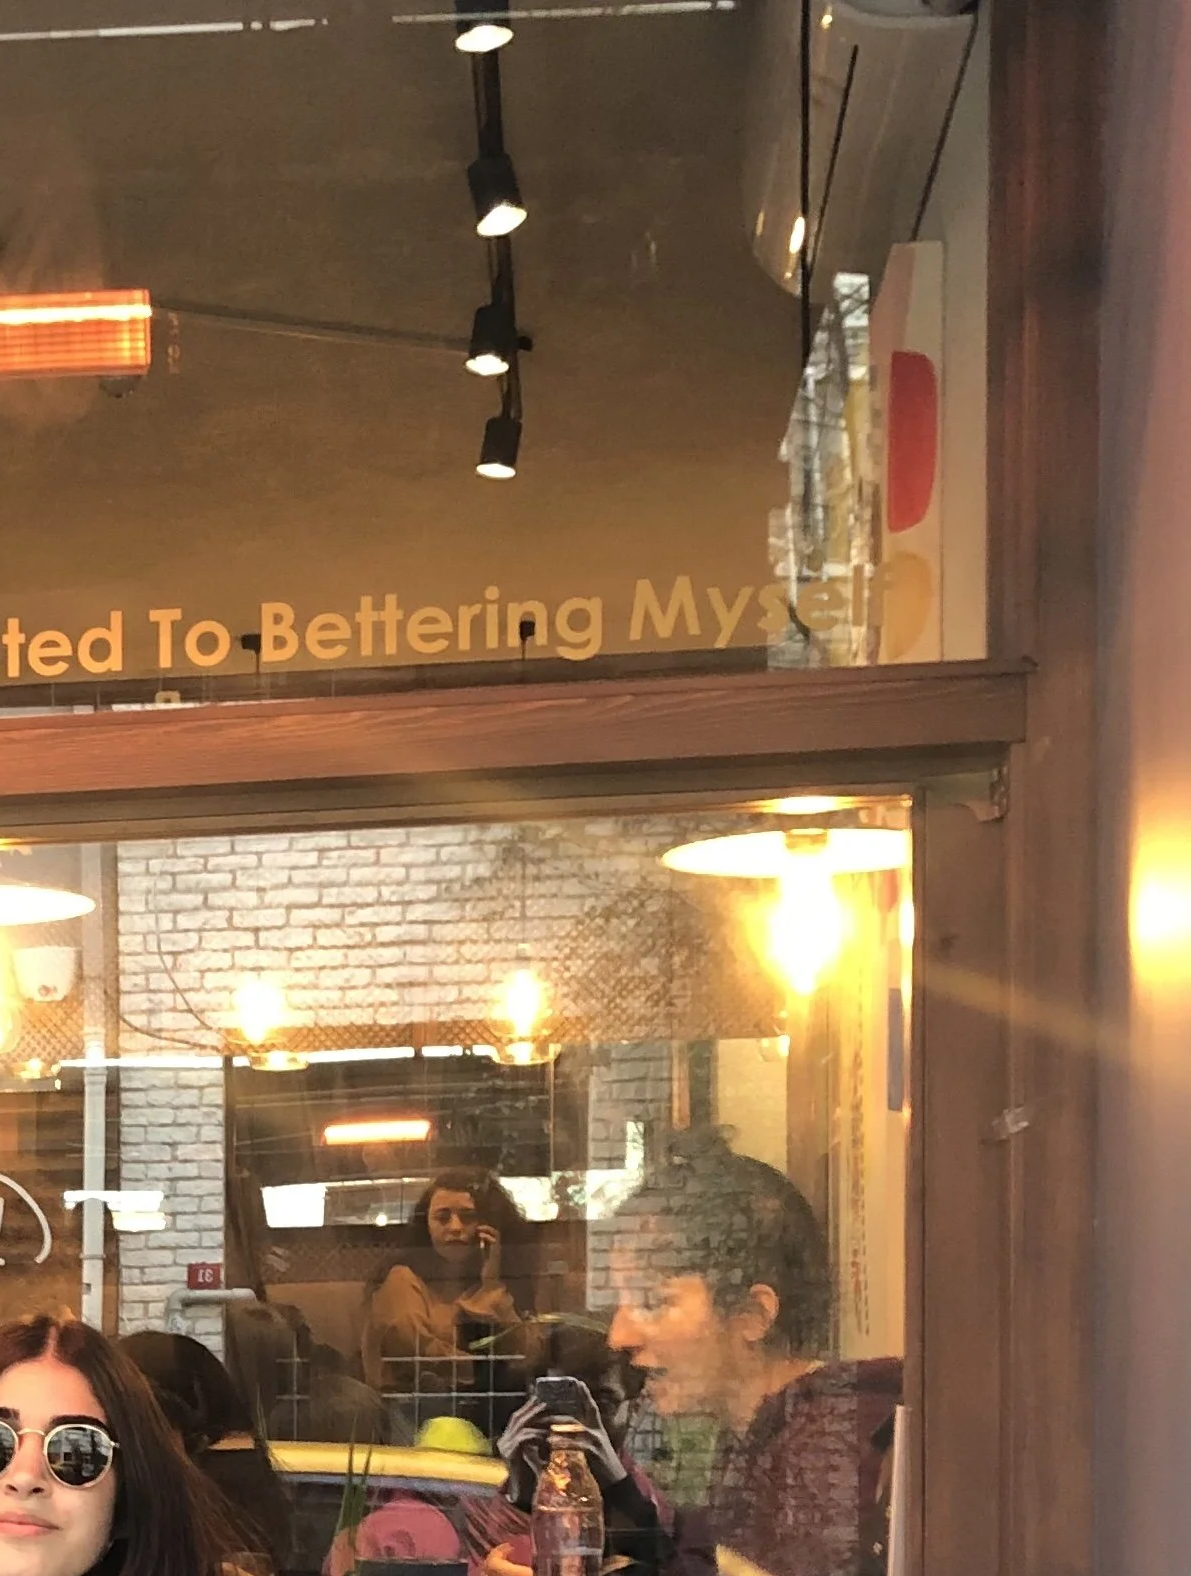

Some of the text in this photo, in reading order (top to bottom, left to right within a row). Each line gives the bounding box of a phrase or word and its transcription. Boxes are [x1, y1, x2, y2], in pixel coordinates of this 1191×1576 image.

[149, 608, 231, 667] To
[260, 585, 603, 662] Bettering
[628, 563, 895, 649] Myself
